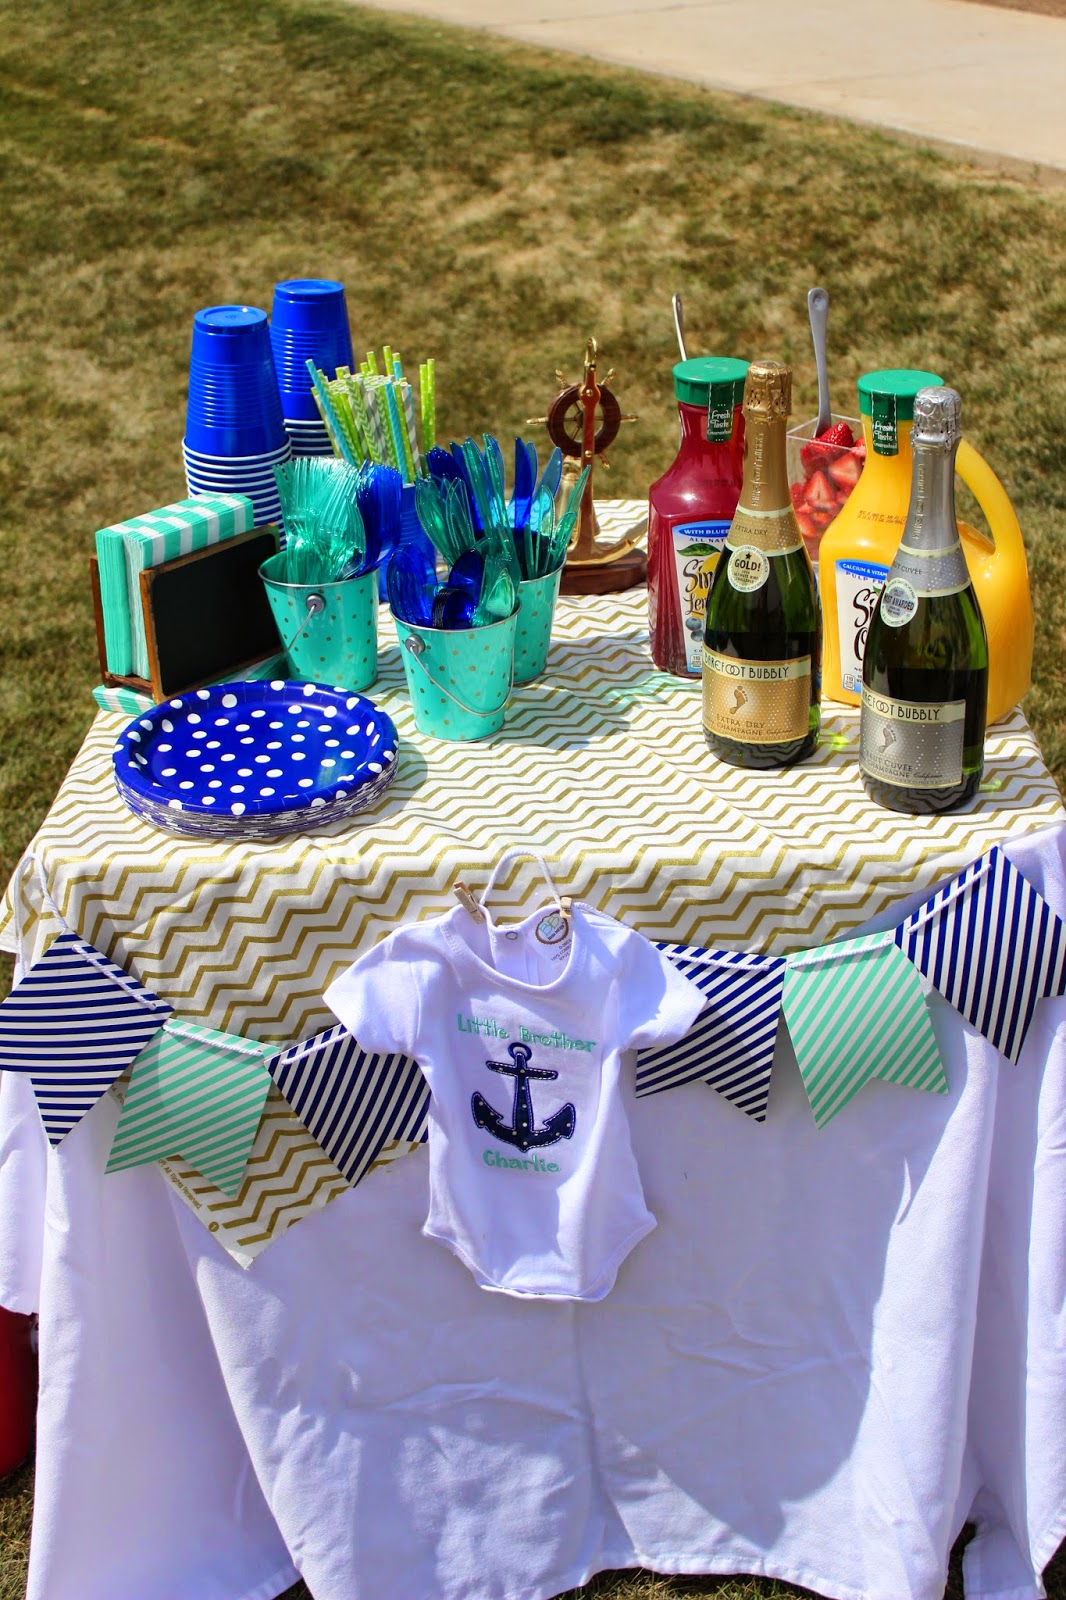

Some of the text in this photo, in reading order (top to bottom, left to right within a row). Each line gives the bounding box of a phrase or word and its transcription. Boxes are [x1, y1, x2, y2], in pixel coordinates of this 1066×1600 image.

[711, 409, 730, 420] Fresh
[710, 419, 729, 428] Taste
[874, 420, 894, 432] Fresh
[873, 430, 893, 441] Taste
[735, 523, 768, 536] EXTRA DRY
[734, 558, 761, 572] GOLD!
[842, 563, 866, 574] CALCIUM
[846, 571, 868, 581] PULP
[892, 597, 915, 611] AWARDED
[704, 652, 790, 679] BAREFOOT BUBBLY
[898, 706, 940, 721] BUBBLY
[716, 713, 766, 729] EXTRA DRY
[716, 723, 763, 736] CHAMPAGNE
[867, 761, 910, 778] CHAMPAGNE
[457, 1013, 597, 1053] Little Brother
[482, 1149, 562, 1173] Charlie
[170, 1172, 184, 1189] Rights
